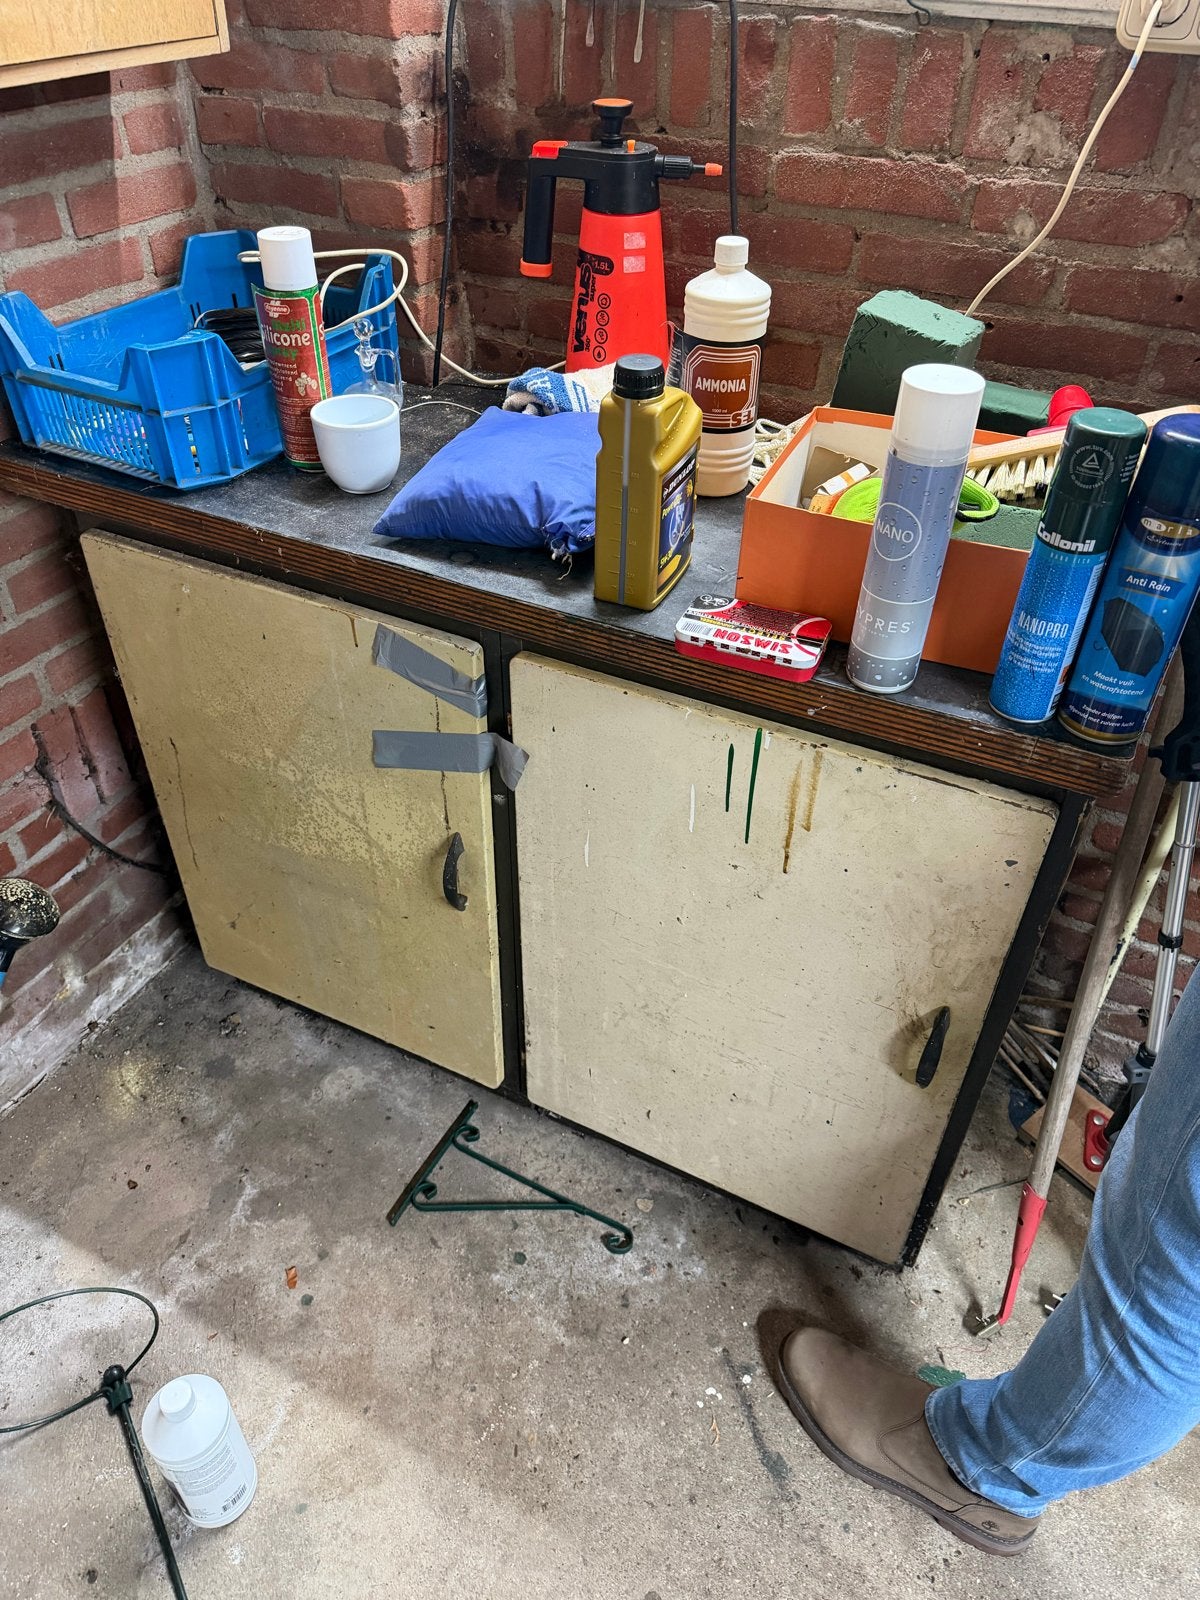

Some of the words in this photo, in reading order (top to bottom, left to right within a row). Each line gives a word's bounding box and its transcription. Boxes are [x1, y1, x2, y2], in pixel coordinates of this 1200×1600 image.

[695, 376, 747, 393] AMMONIA
[876, 519, 914, 544] NANO
[1037, 521, 1096, 553] Collonil
[1126, 575, 1149, 587] Anti
[1149, 580, 1171, 593] Rain
[1018, 610, 1069, 639] NANOPRO
[712, 628, 793, 654] SIMSON
[1081, 674, 1090, 682] en
[1093, 671, 1118, 684] Maakt
[1118, 679, 1135, 687] vuil-
